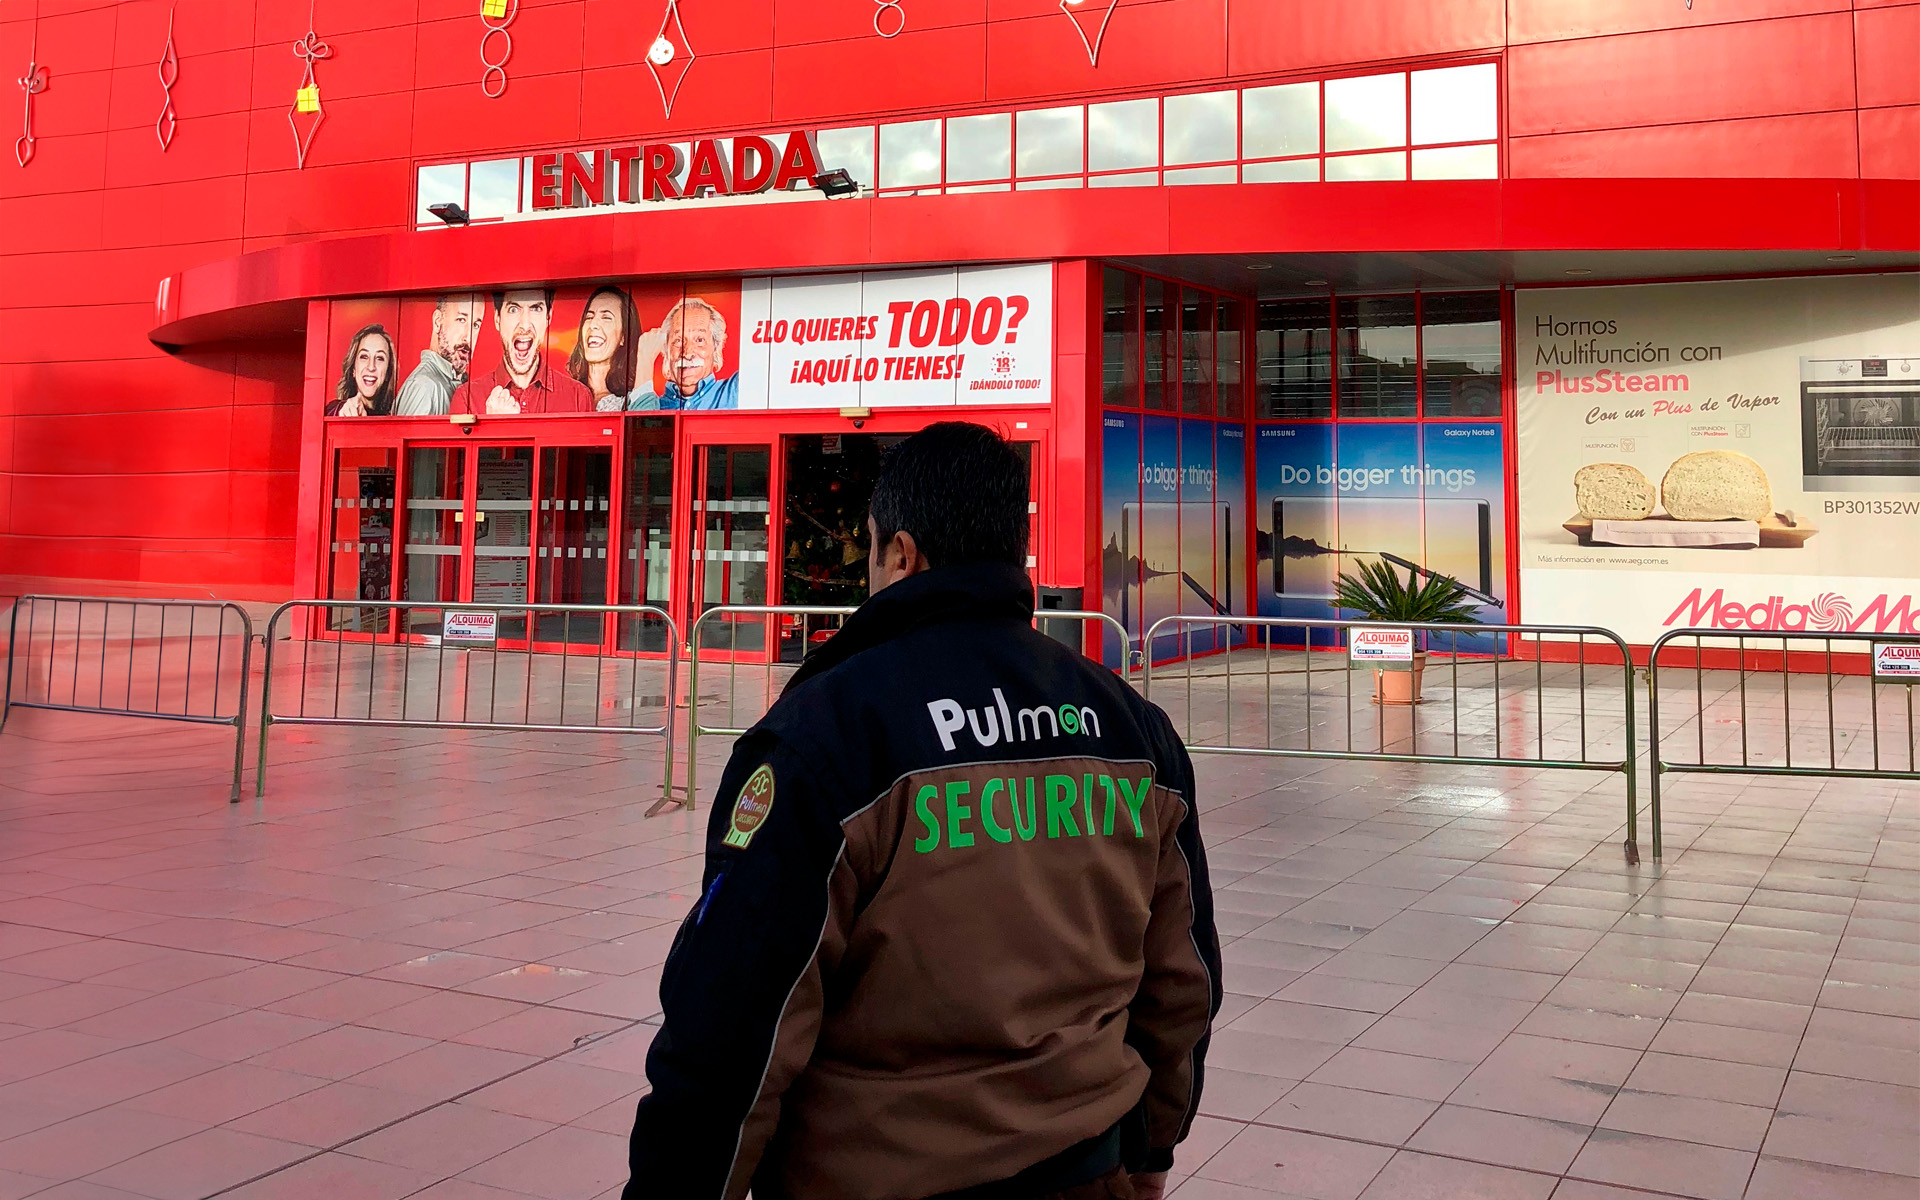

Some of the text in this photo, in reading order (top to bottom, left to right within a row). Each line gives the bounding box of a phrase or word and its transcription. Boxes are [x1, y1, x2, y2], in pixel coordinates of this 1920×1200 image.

[532, 130, 824, 210] ENTRADA
[751, 295, 1029, 348] ¿LO QUIERES TODO?
[1535, 314, 1618, 337] Hornos
[996, 356, 1011, 368] 18
[1535, 338, 1722, 366] Multifunción con
[790, 353, 965, 386] ¡AQUÍ LO TIENES!
[969, 378, 1042, 391] ¡DÁNDOLO TODO!
[1536, 368, 1689, 395] PlusSteam
[1585, 393, 1782, 426] Con un Plus de Vapor
[1103, 418, 1125, 428] SAMSUNG
[1261, 429, 1297, 437] SAMSUNG
[1444, 428, 1496, 438] Galaxy Note8
[1280, 462, 1477, 493] Do bigger things
[1824, 500, 1920, 515] BP301352W
[1537, 554, 1669, 566] Más información en www.aeg.com.es
[447, 614, 495, 625] ALQUIMAQ
[1662, 588, 1810, 631] Media
[1354, 631, 1410, 643] ALQUIMAQ
[915, 773, 1152, 853] SECURITY
